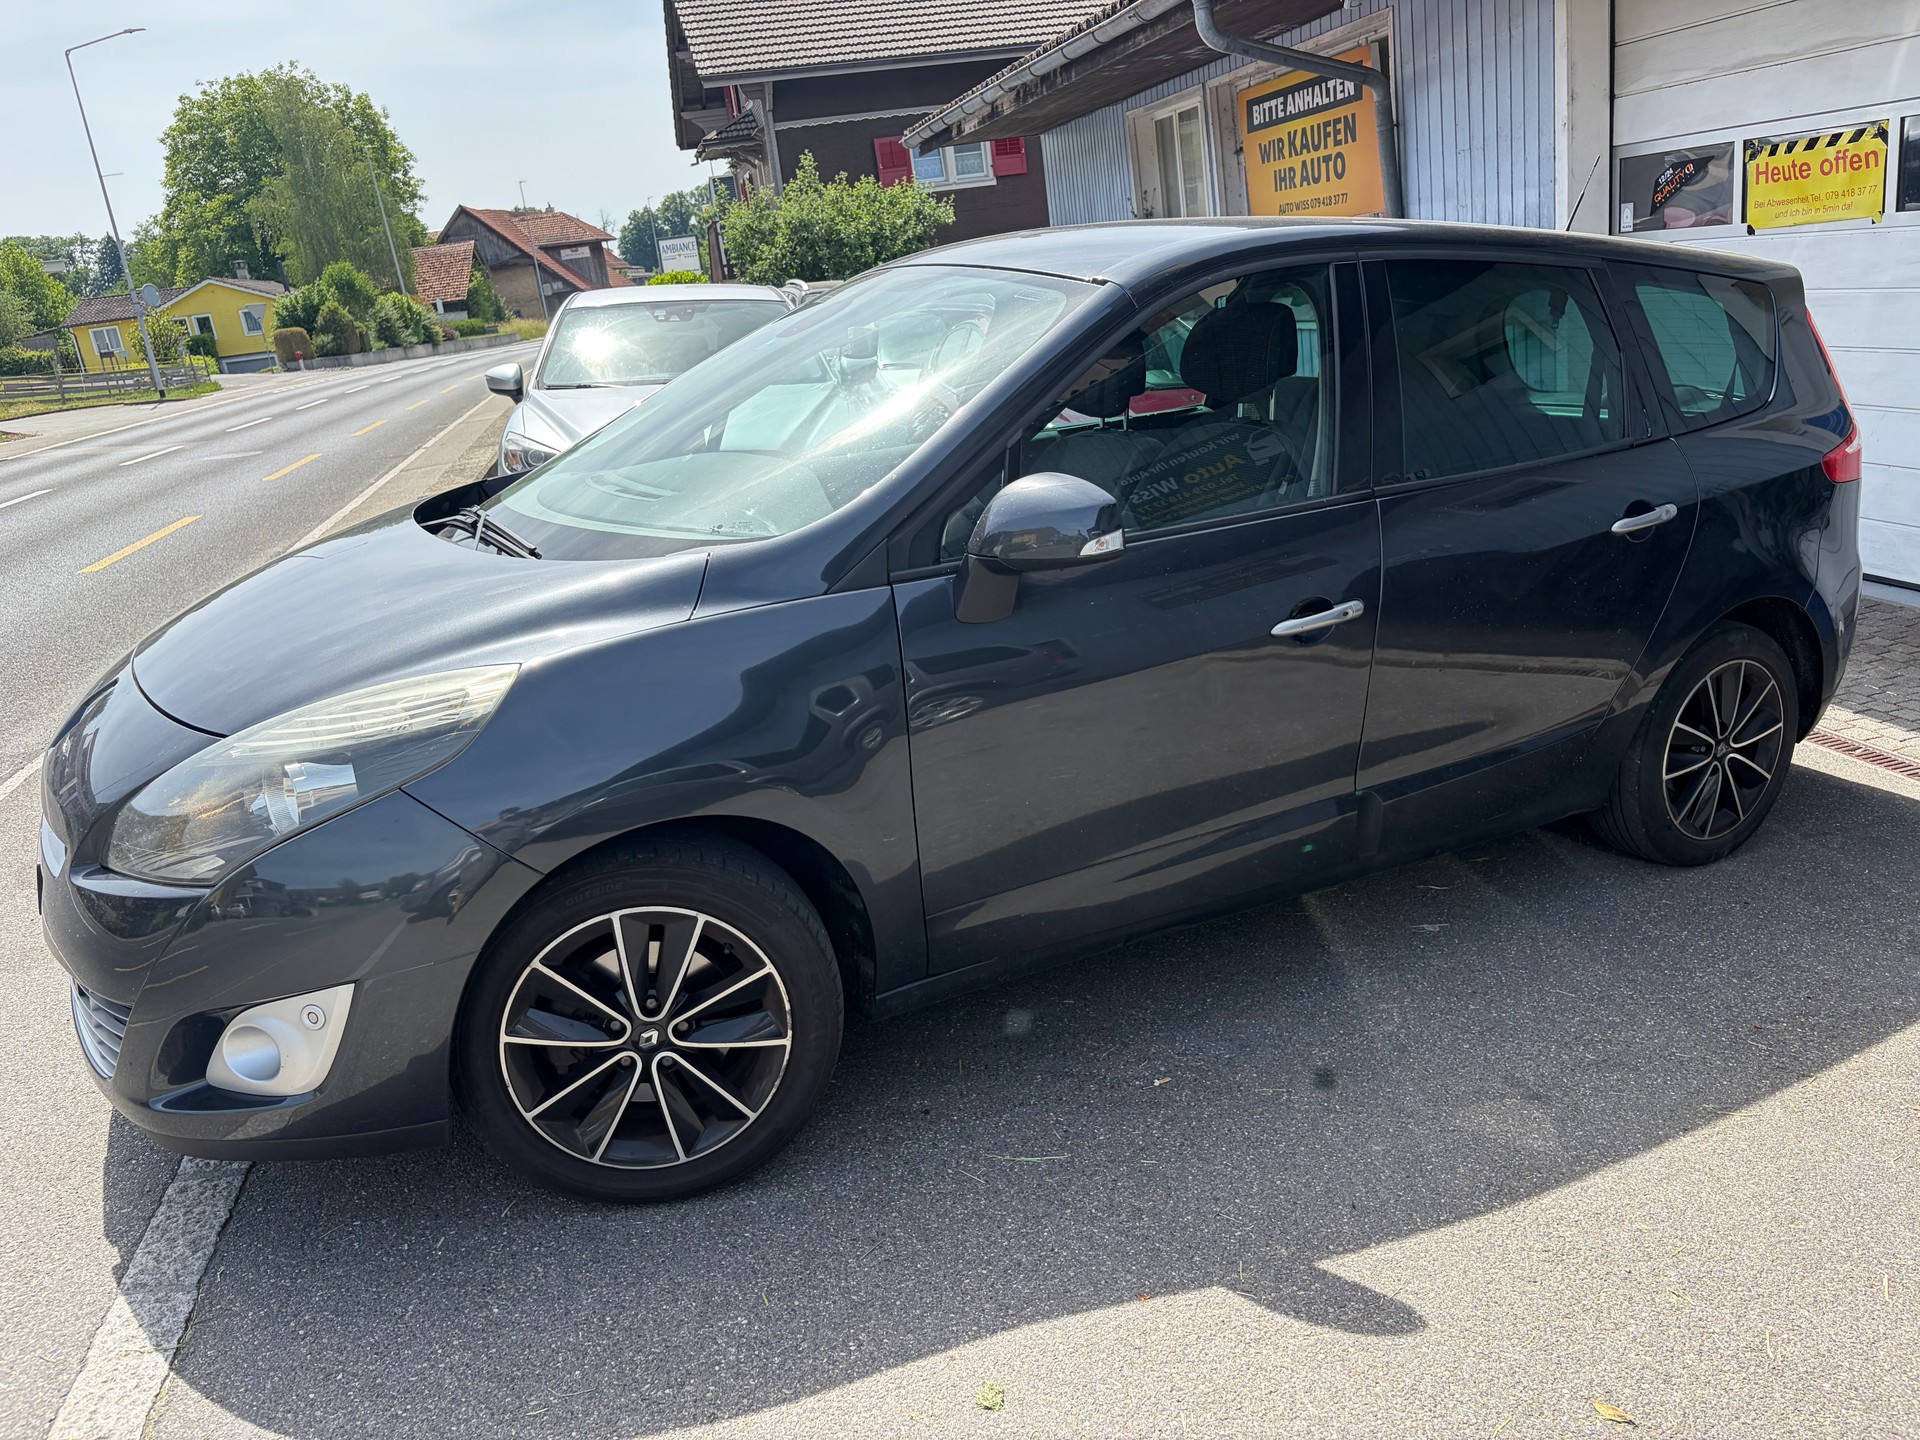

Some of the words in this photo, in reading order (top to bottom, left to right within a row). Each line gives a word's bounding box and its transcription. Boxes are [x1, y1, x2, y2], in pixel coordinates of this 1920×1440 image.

[1252, 96, 1284, 126] BITTE
[1286, 78, 1355, 116] ANHALTEN
[1258, 137, 1285, 165] WIR
[1287, 112, 1357, 158] KAUFEN
[1273, 166, 1297, 192] IHR
[1299, 151, 1346, 187] AUTO
[1755, 158, 1812, 186] Heute
[1819, 148, 1879, 176] offen
[1654, 169, 1686, 203] QUALITY
[1754, 200, 1766, 209] Bei
[1810, 193, 1823, 203] Tel.
[1825, 191, 1839, 201] 079
[1841, 188, 1855, 198] 418
[1857, 186, 1867, 196] 37
[1868, 185, 1877, 194] 77
[1279, 202, 1294, 215] AUTO
[1295, 199, 1310, 212] WISS
[1310, 197, 1321, 209] 079
[1321, 195, 1332, 207] 418
[1333, 194, 1341, 205] 37
[1341, 193, 1348, 204] 77
[1774, 209, 1788, 219] und
[1789, 208, 1799, 217] ich
[1802, 206, 1812, 215] bin
[1814, 205, 1821, 214] in
[1822, 204, 1839, 213] 5min
[1841, 201, 1854, 211] da!
[661, 241, 696, 255] AMBIANCE
[566, 881, 624, 906] OUTSIDE
